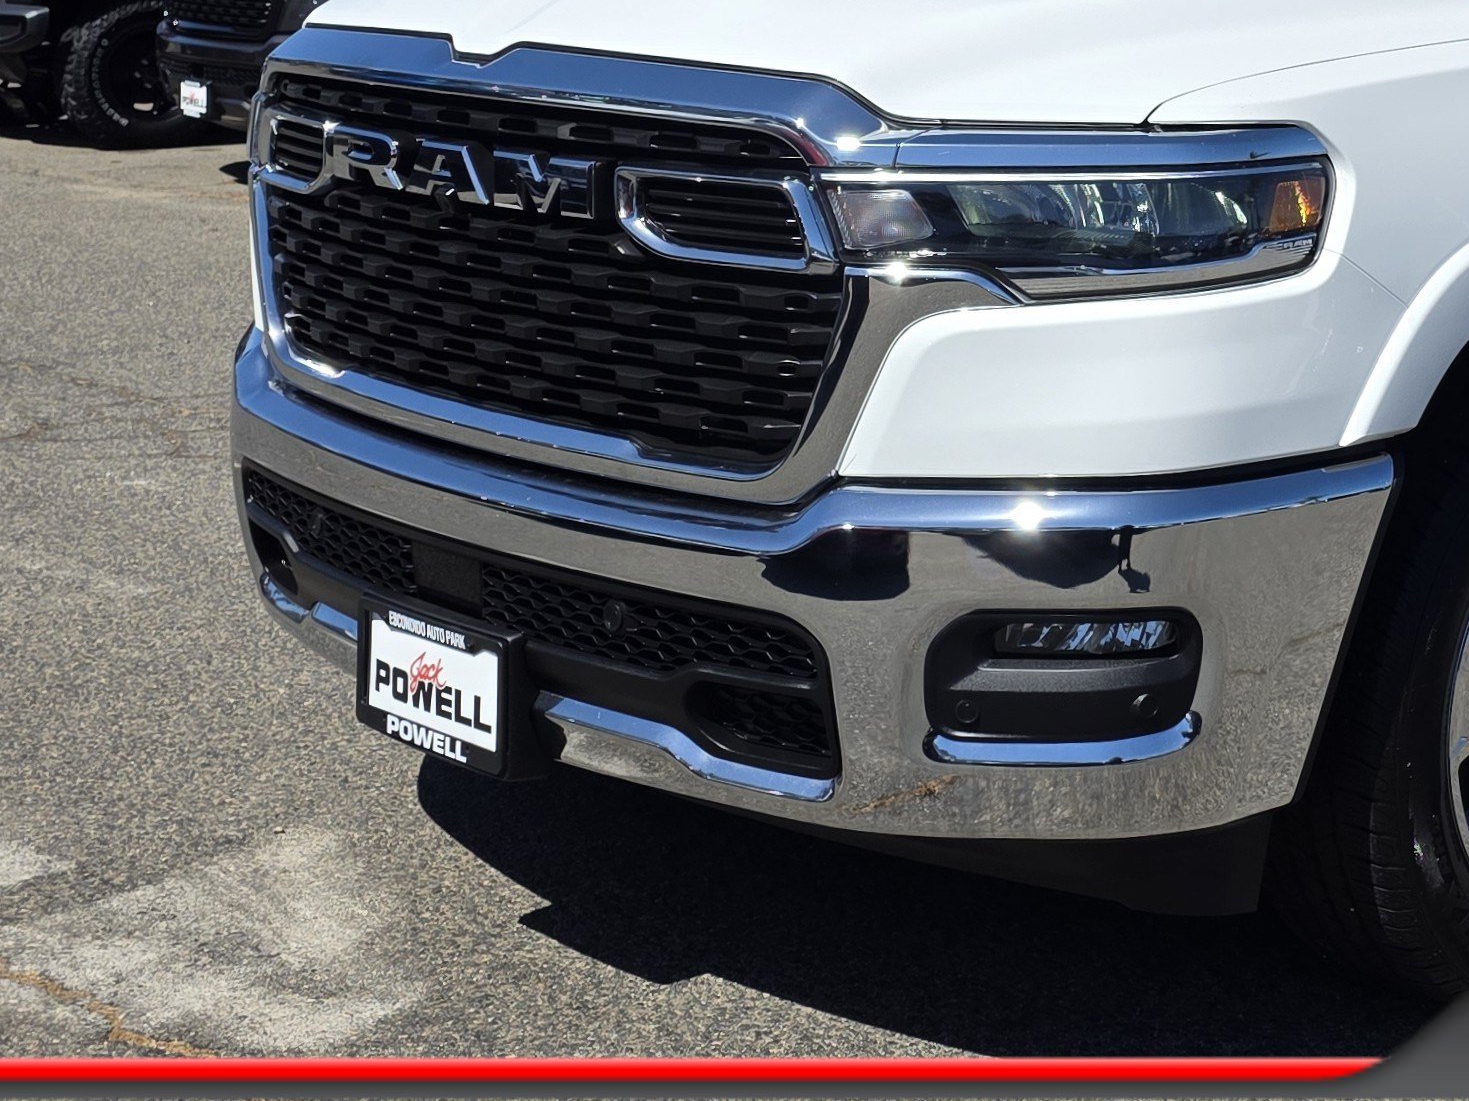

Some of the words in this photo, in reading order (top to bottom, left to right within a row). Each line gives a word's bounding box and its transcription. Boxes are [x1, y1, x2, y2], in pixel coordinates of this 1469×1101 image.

[330, 122, 597, 219] RAM
[426, 623, 446, 644] AUTO
[445, 630, 466, 650] PARK
[375, 658, 493, 735] POWELL
[409, 651, 447, 693] Jack
[386, 714, 468, 764] POWELL
